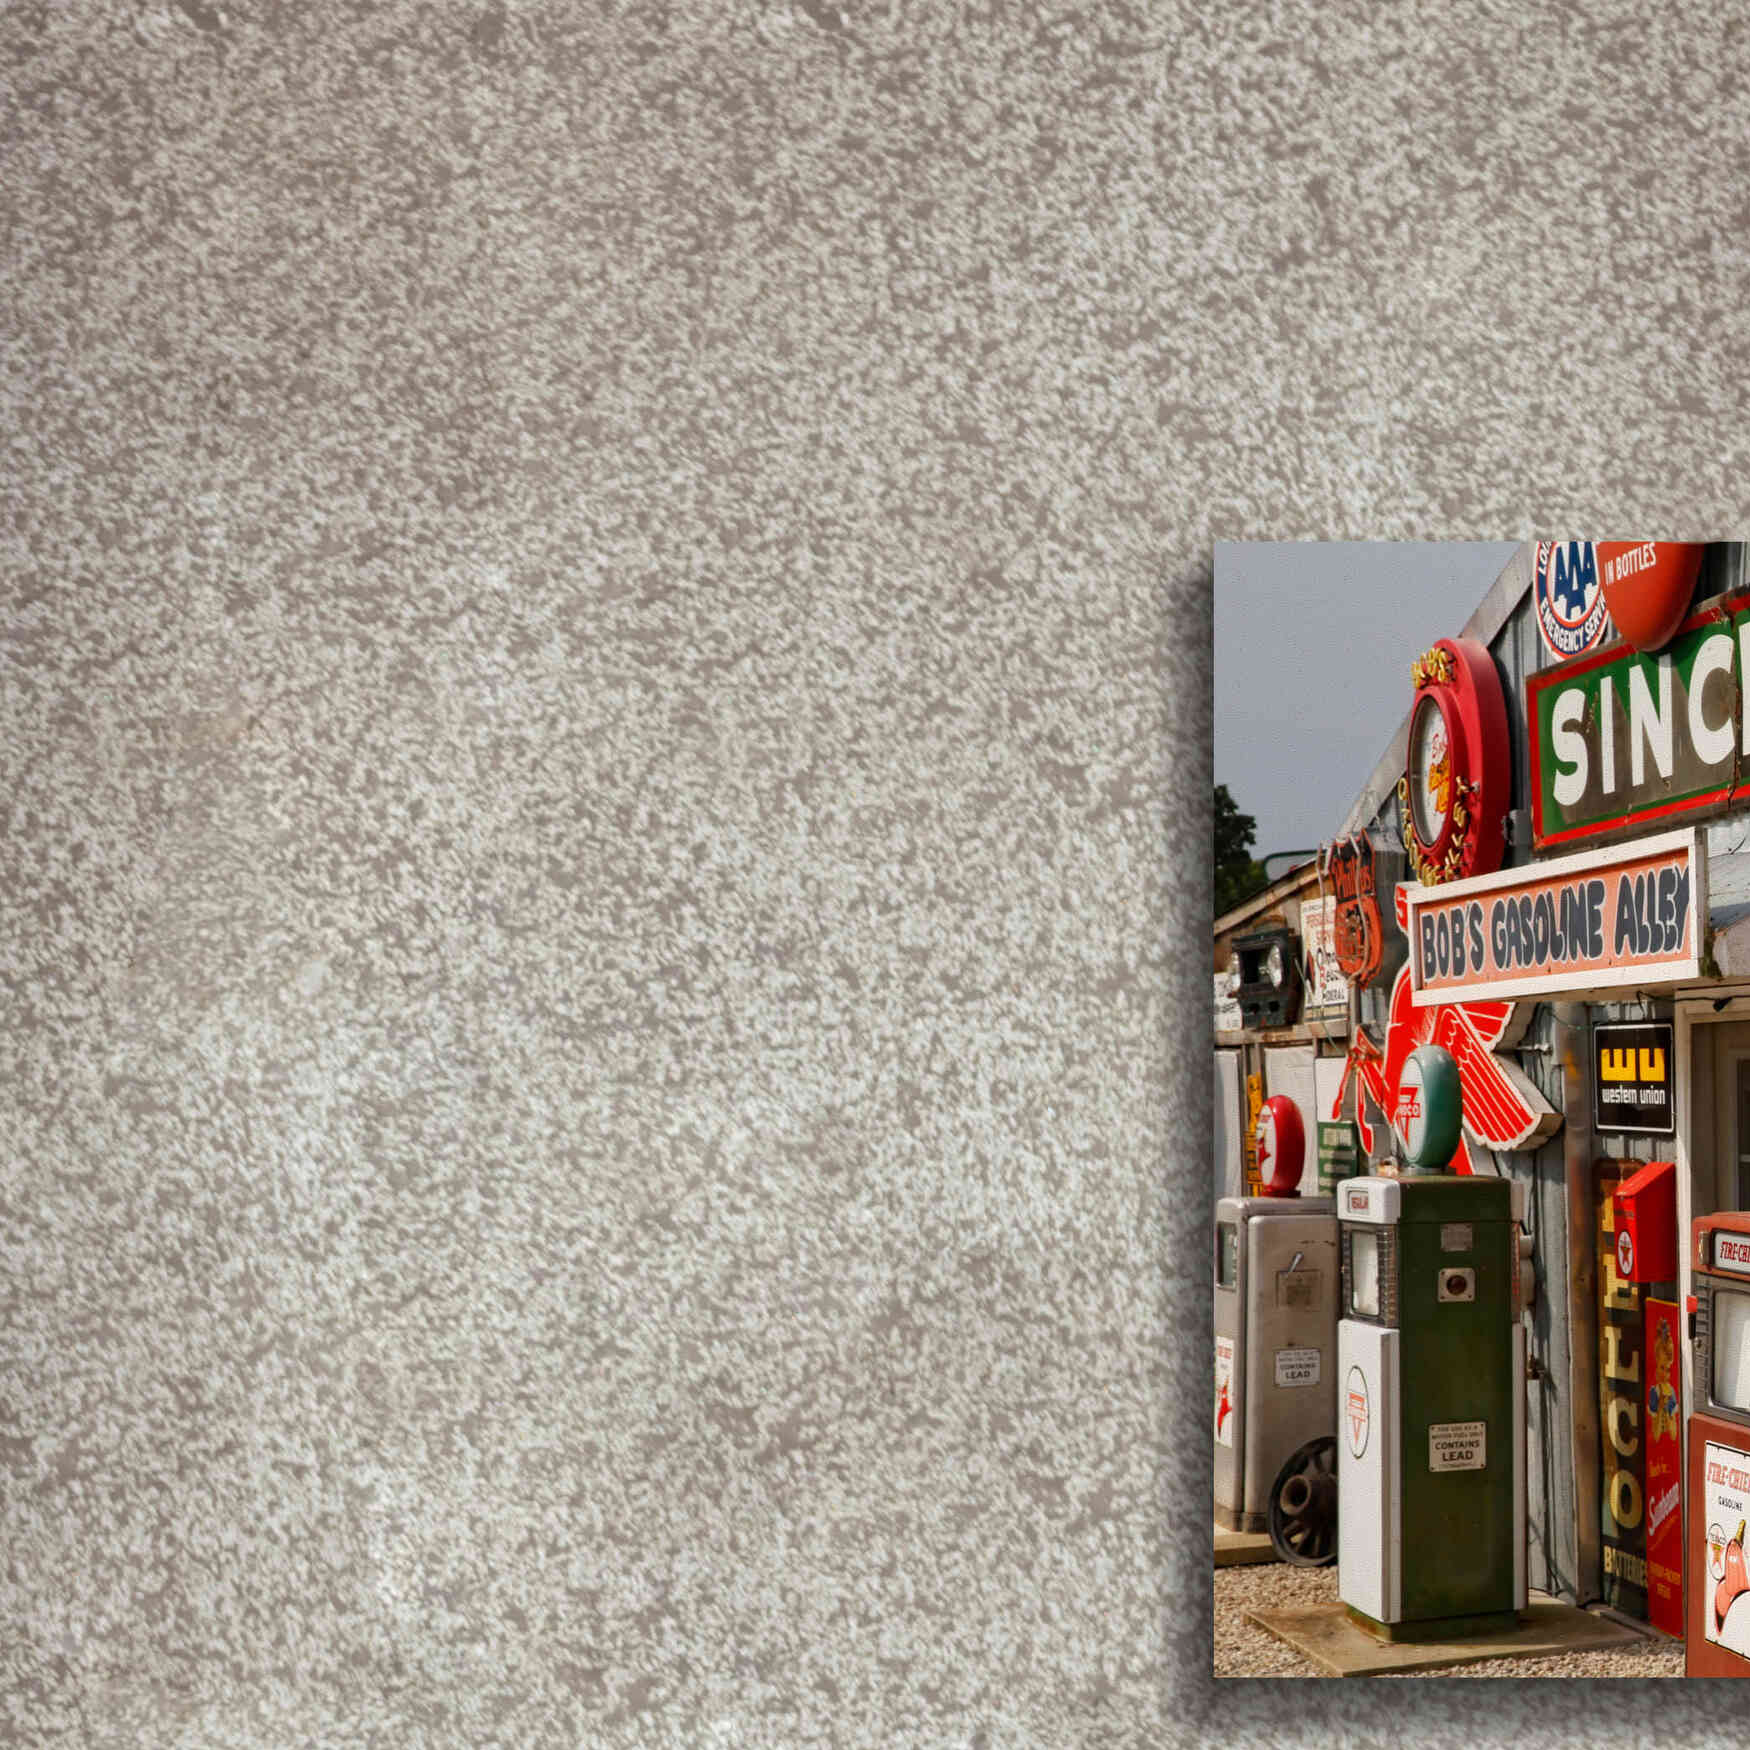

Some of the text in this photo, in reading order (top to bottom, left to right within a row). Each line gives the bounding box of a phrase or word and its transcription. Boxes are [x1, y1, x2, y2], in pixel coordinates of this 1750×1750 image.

[1604, 542, 1657, 586] IN BOTTLES
[1552, 541, 1598, 621] AAA
[1540, 597, 1584, 651] EMERGENCY
[1421, 863, 1690, 982] BOB'S GASOLINE ALLEY
[1602, 1085, 1666, 1105] western union
[1285, 1370, 1312, 1380] LEAD
[1434, 1440, 1481, 1450] CONTAINS
[1442, 1450, 1474, 1462] LEAD
[1718, 1495, 1744, 1513] GASOLINE
